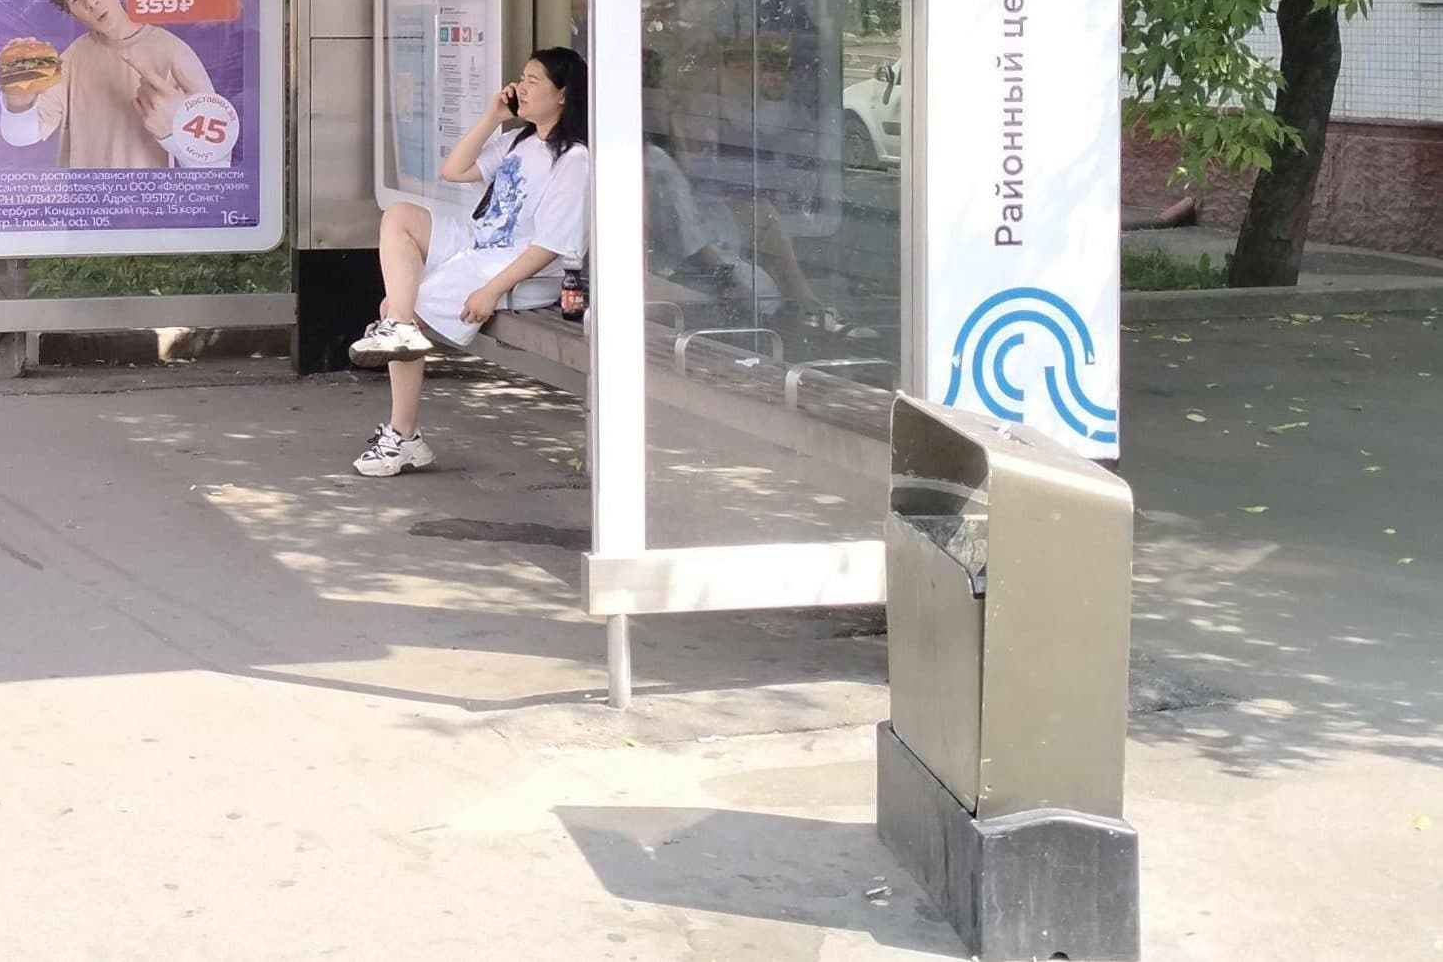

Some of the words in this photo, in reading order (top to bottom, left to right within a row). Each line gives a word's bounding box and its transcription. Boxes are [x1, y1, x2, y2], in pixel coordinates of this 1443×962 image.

[182, 115, 228, 144] 45
[994, 51, 1024, 247] Районный
[40, 172, 91, 182] доставки
[92, 172, 134, 180] зависит
[136, 172, 149, 180] от
[174, 169, 245, 181] подробности
[30, 181, 128, 193] msk.dostaevsky.ru
[129, 181, 157, 191] ООО
[44, 205, 134, 216] Кондратьевский
[168, 204, 178, 214] 15
[92, 216, 110, 227] 105
[221, 210, 250, 225] 16+
